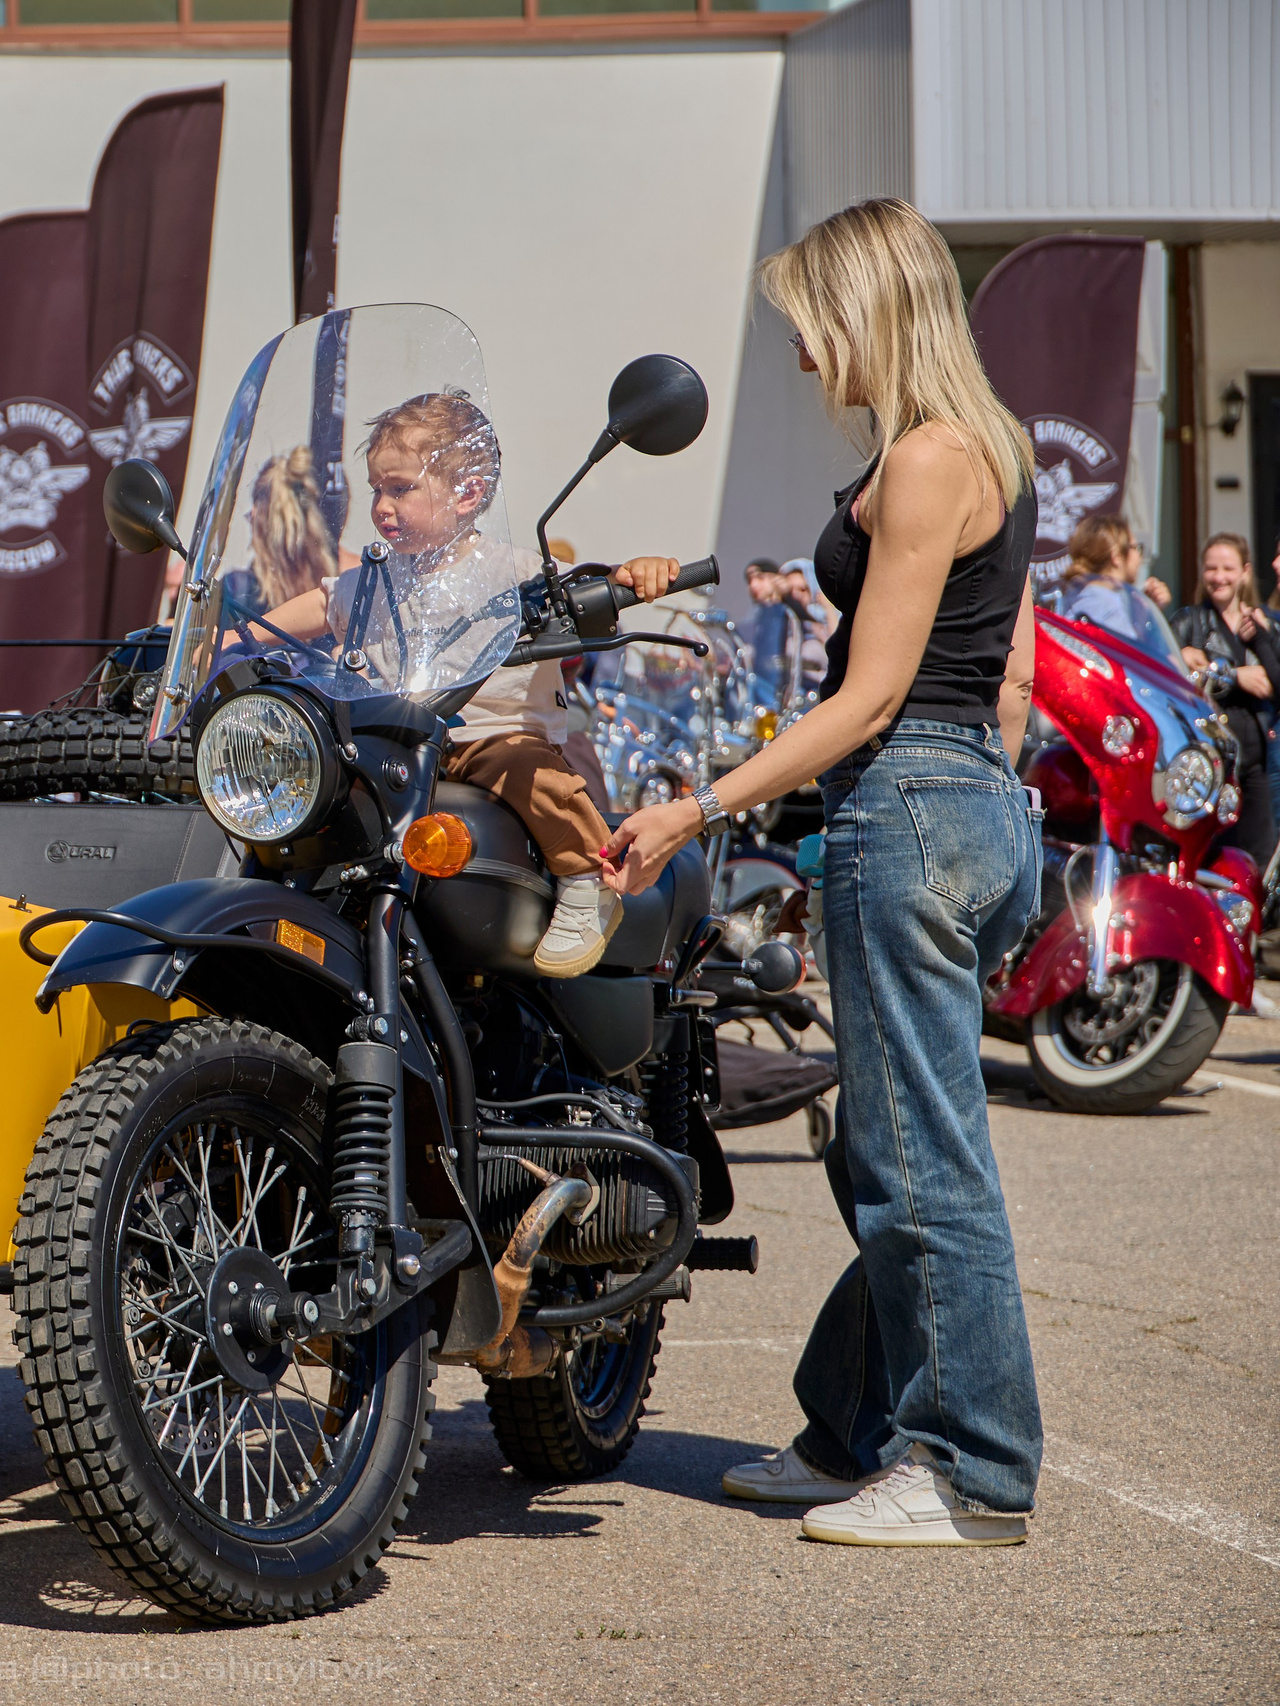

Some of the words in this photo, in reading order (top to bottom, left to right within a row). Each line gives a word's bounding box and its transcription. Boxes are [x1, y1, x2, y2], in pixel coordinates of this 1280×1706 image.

[6, 402, 85, 449] BANKERS
[1033, 420, 1108, 468] BANKERS
[69, 845, 116, 860] URAL
